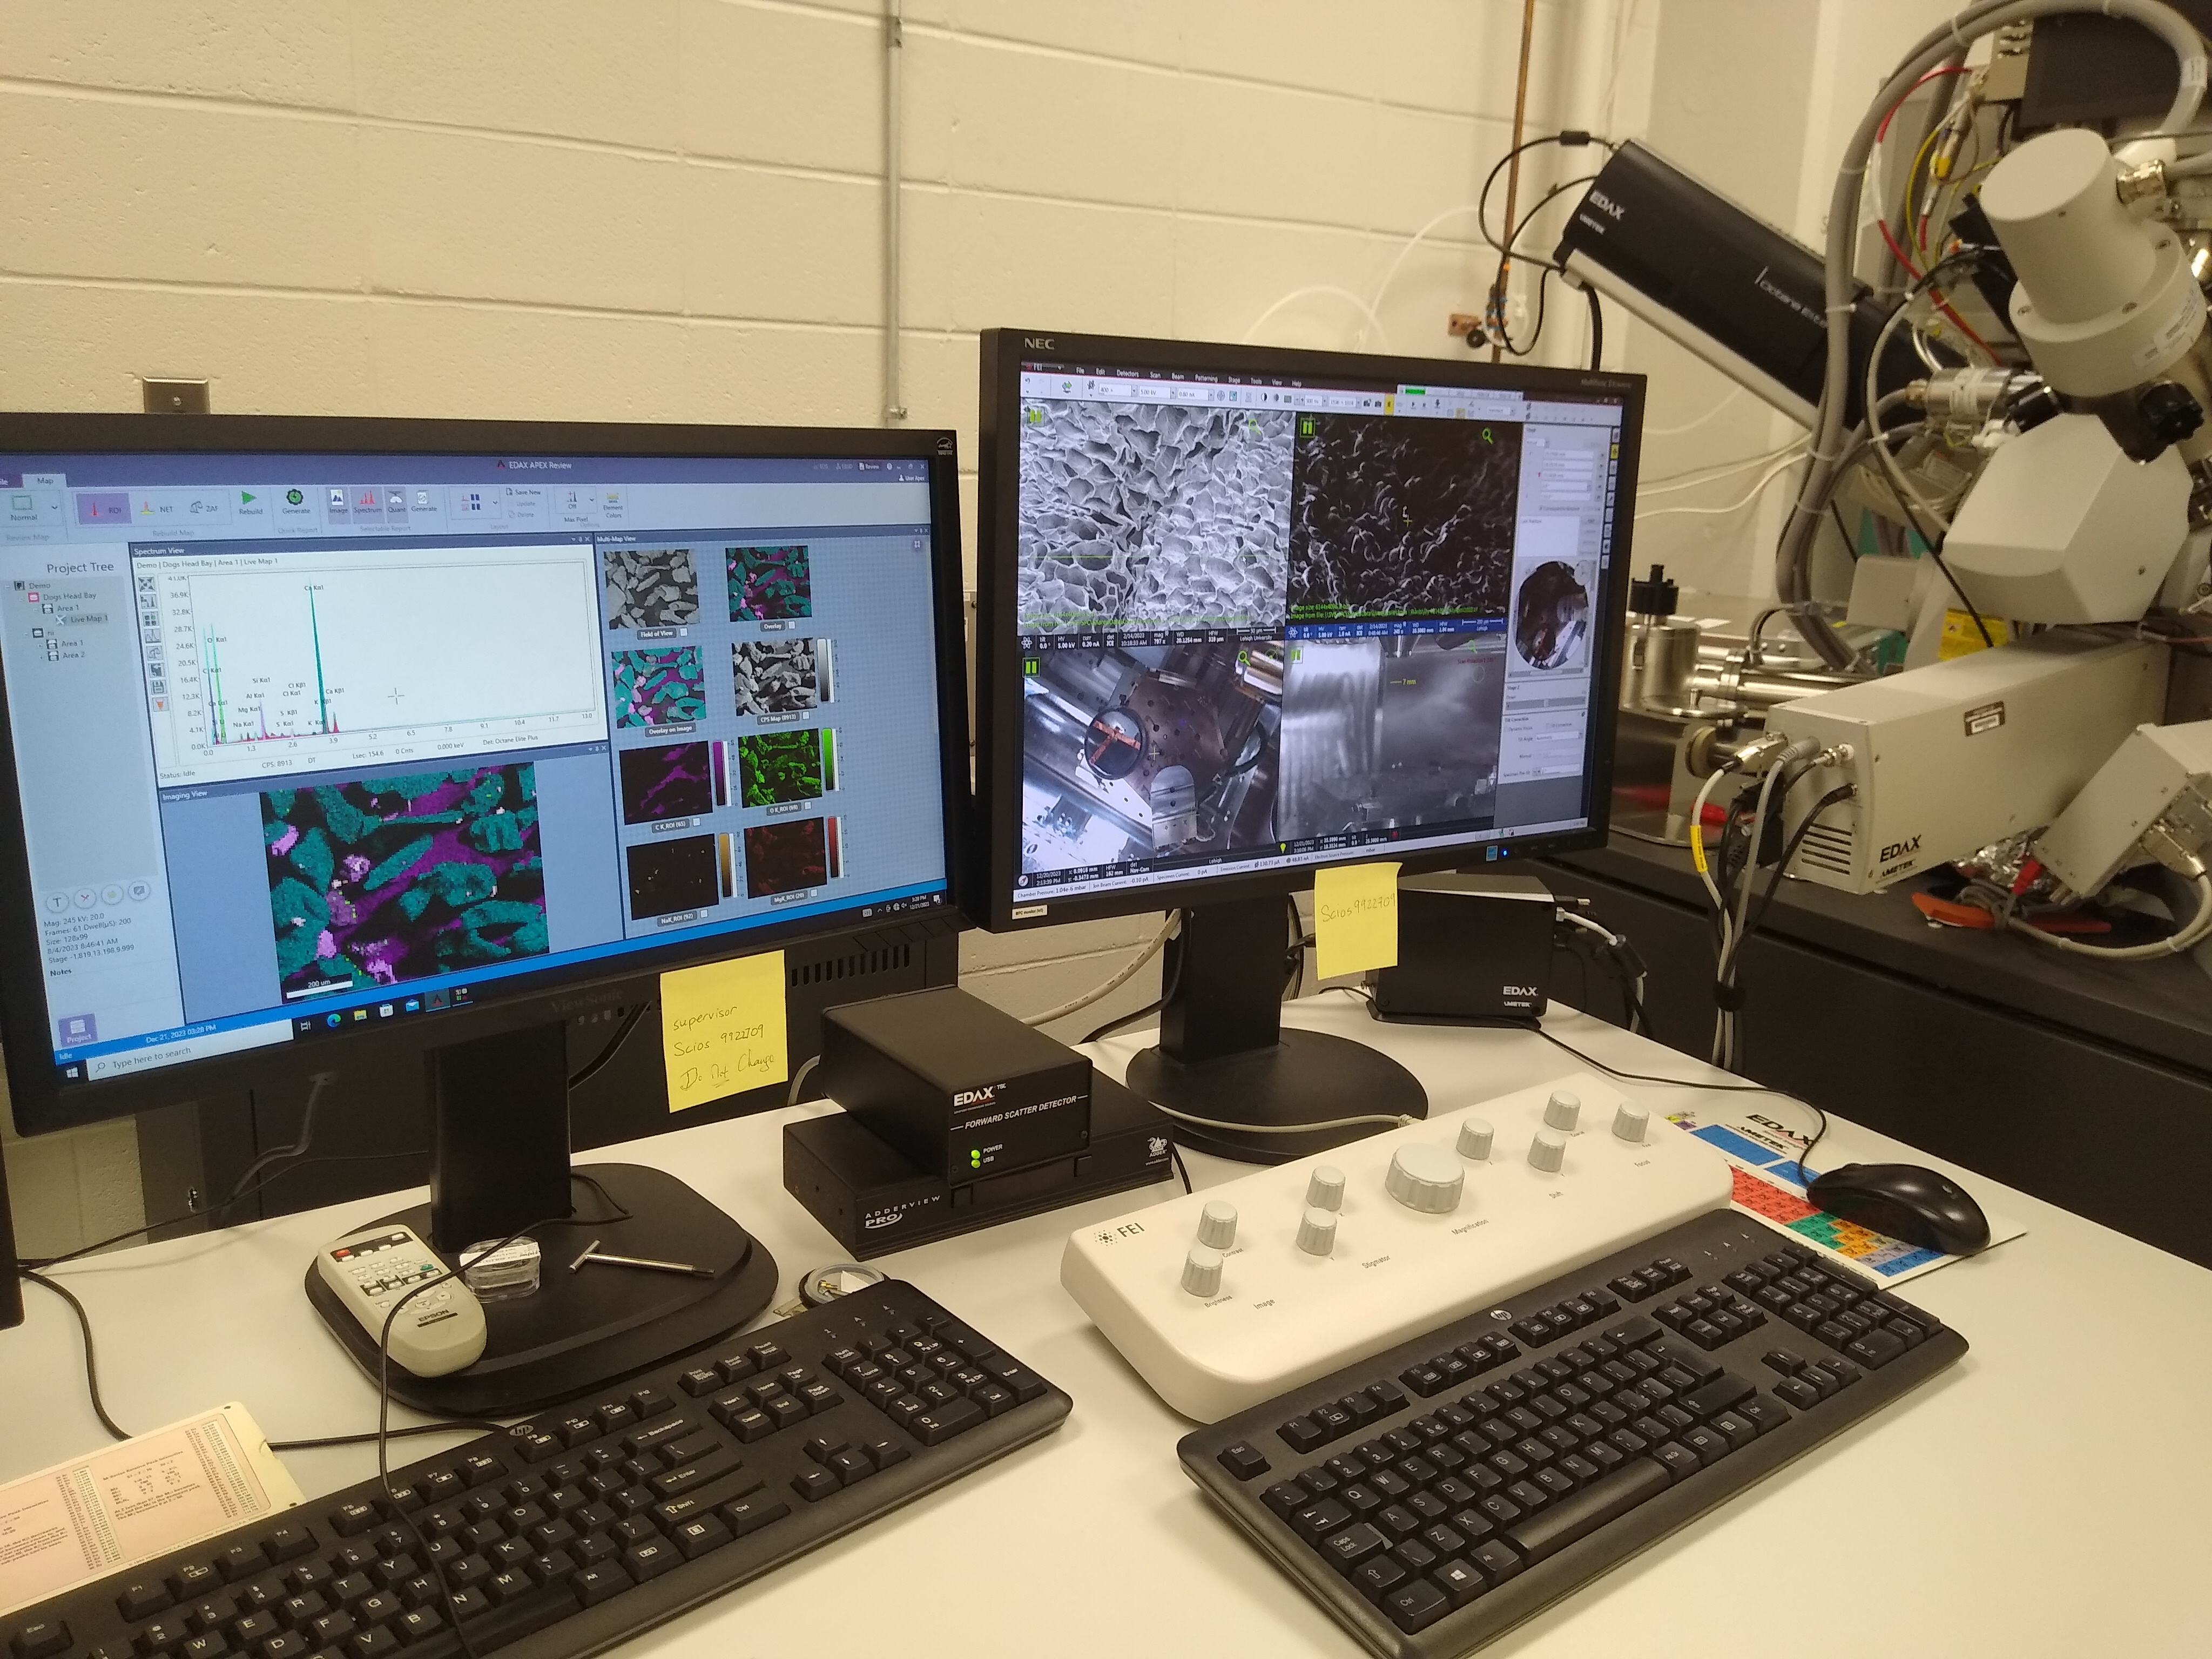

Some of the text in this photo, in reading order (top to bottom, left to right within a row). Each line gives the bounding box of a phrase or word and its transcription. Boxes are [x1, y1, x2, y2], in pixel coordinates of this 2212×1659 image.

[1589, 190, 1625, 220] EDAX
[1024, 338, 1054, 350] NEC
[1228, 376, 1240, 384] Stage
[509, 461, 528, 469] EDAX
[38, 477, 53, 485] Map
[47, 563, 114, 575] Project Tree
[770, 714, 781, 723] Map
[678, 725, 692, 733] Image
[163, 790, 207, 801] Imaging View
[1879, 834, 1922, 864] EDAX
[1321, 893, 1395, 922] Scios 9922709
[45, 927, 71, 936] Frames:
[1502, 986, 1537, 996] EDAX
[673, 1006, 737, 1031] supervisor
[67, 1033, 91, 1043] Project
[171, 1030, 186, 1038] 2023
[674, 1041, 710, 1056] Scios
[113, 1061, 132, 1069] Type
[134, 1055, 152, 1063] here
[165, 1047, 191, 1058] search
[954, 1086, 994, 1107] EDAX
[965, 1114, 1003, 1130] FORWARD
[1004, 1105, 1037, 1120] SCATTER
[1038, 1095, 1077, 1111] DETECTOR
[1745, 1114, 1815, 1146] EDAX
[983, 1144, 1003, 1154] POWER
[866, 1195, 940, 1219] ADDERVIEW
[865, 1213, 898, 1226] PRO
[1117, 1222, 1145, 1238] FEI
[1451, 1218, 1489, 1236] Magnification
[1222, 1248, 1244, 1258] Contrast
[1361, 1255, 1391, 1270] Stigmator
[1204, 1295, 1232, 1309] Brightness
[1253, 1298, 1276, 1310] Image
[418, 1309, 449, 1322] EPSON
[1490, 1310, 1512, 1321] hp
[649, 1419, 684, 1437] Backspace
[678, 1469, 696, 1479] Enter
[1377, 1475, 1390, 1485] W
[1348, 1490, 1362, 1500] Q
[677, 1499, 695, 1509] Shift
[736, 1504, 749, 1512] Ctrl
[1333, 1536, 1351, 1547] Caps
[1340, 1541, 1358, 1552] Lock
[292, 1599, 305, 1608] R
